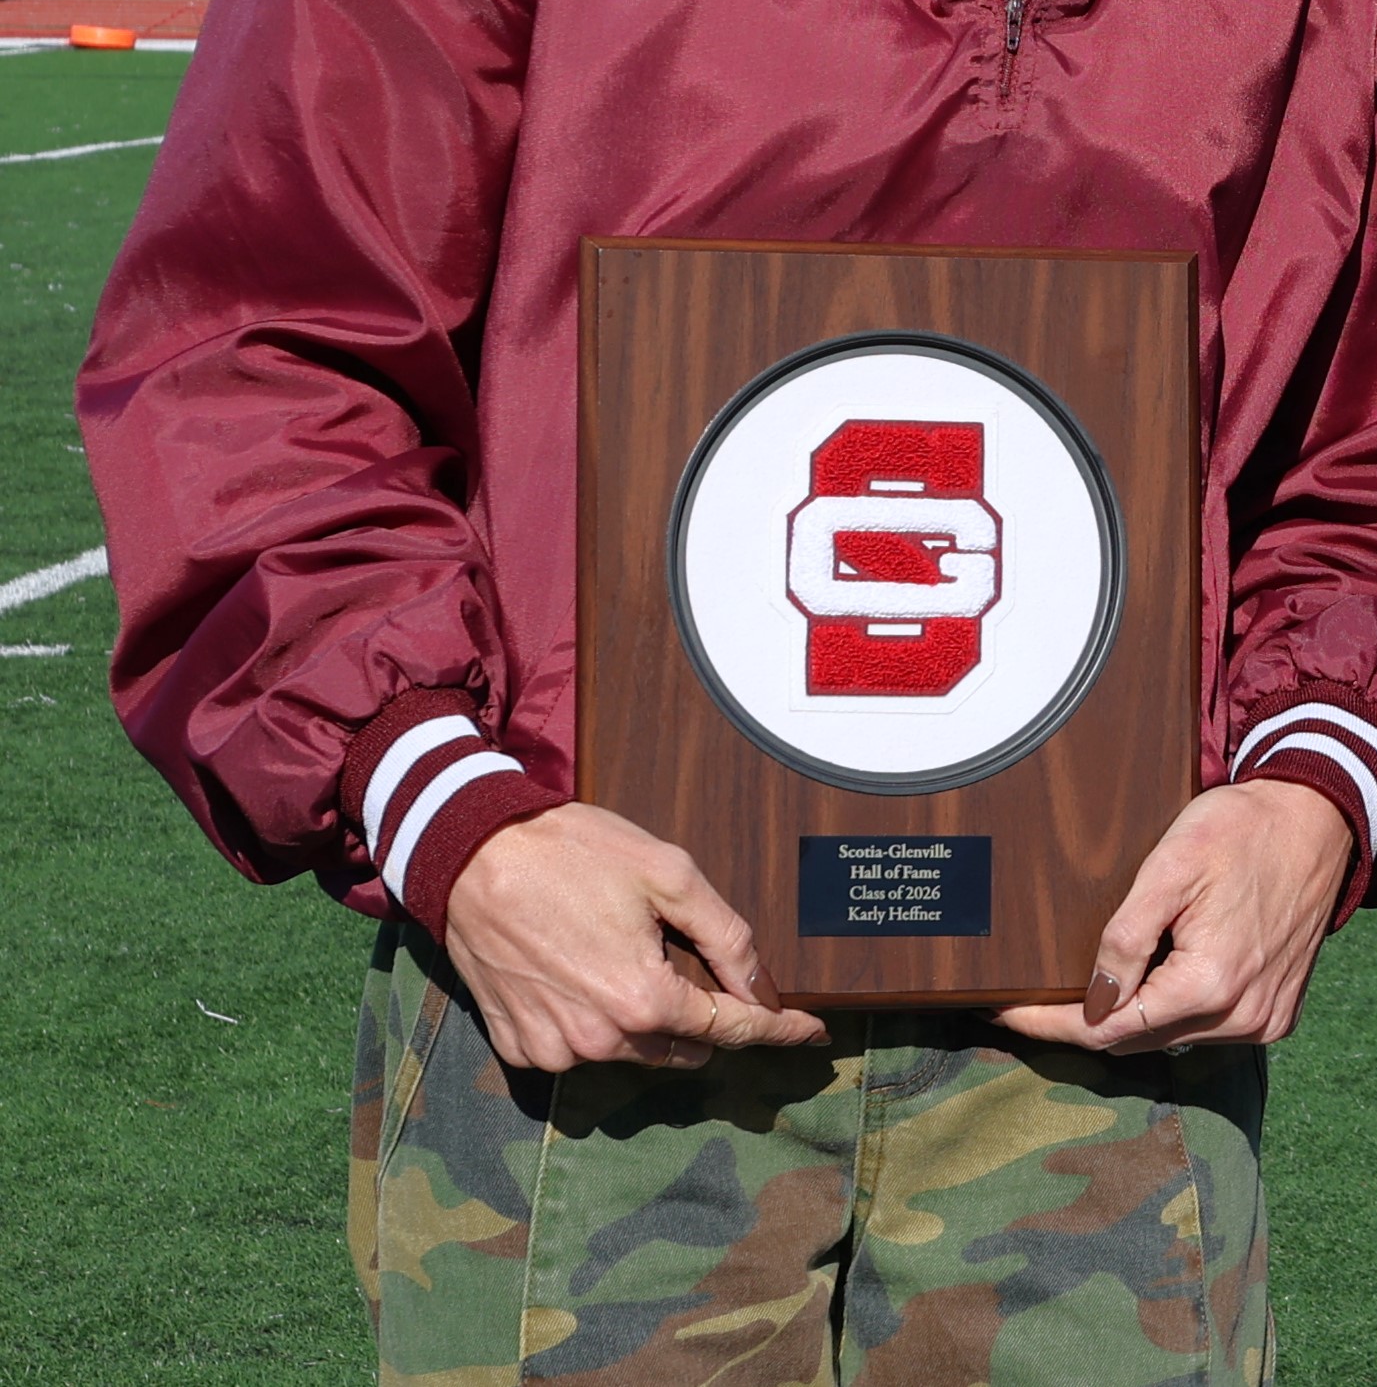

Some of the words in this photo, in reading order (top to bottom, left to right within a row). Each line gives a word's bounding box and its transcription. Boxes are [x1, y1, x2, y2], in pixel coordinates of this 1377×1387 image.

[838, 843, 953, 859] Scotia-Glenville
[850, 864, 882, 879] Hall
[884, 863, 902, 879] of
[902, 865, 941, 879] Fame
[849, 884, 886, 900] Class
[888, 884, 905, 900] of
[905, 884, 942, 900] 2026
[847, 905, 886, 925] Karly
[888, 905, 942, 921] Heffner
